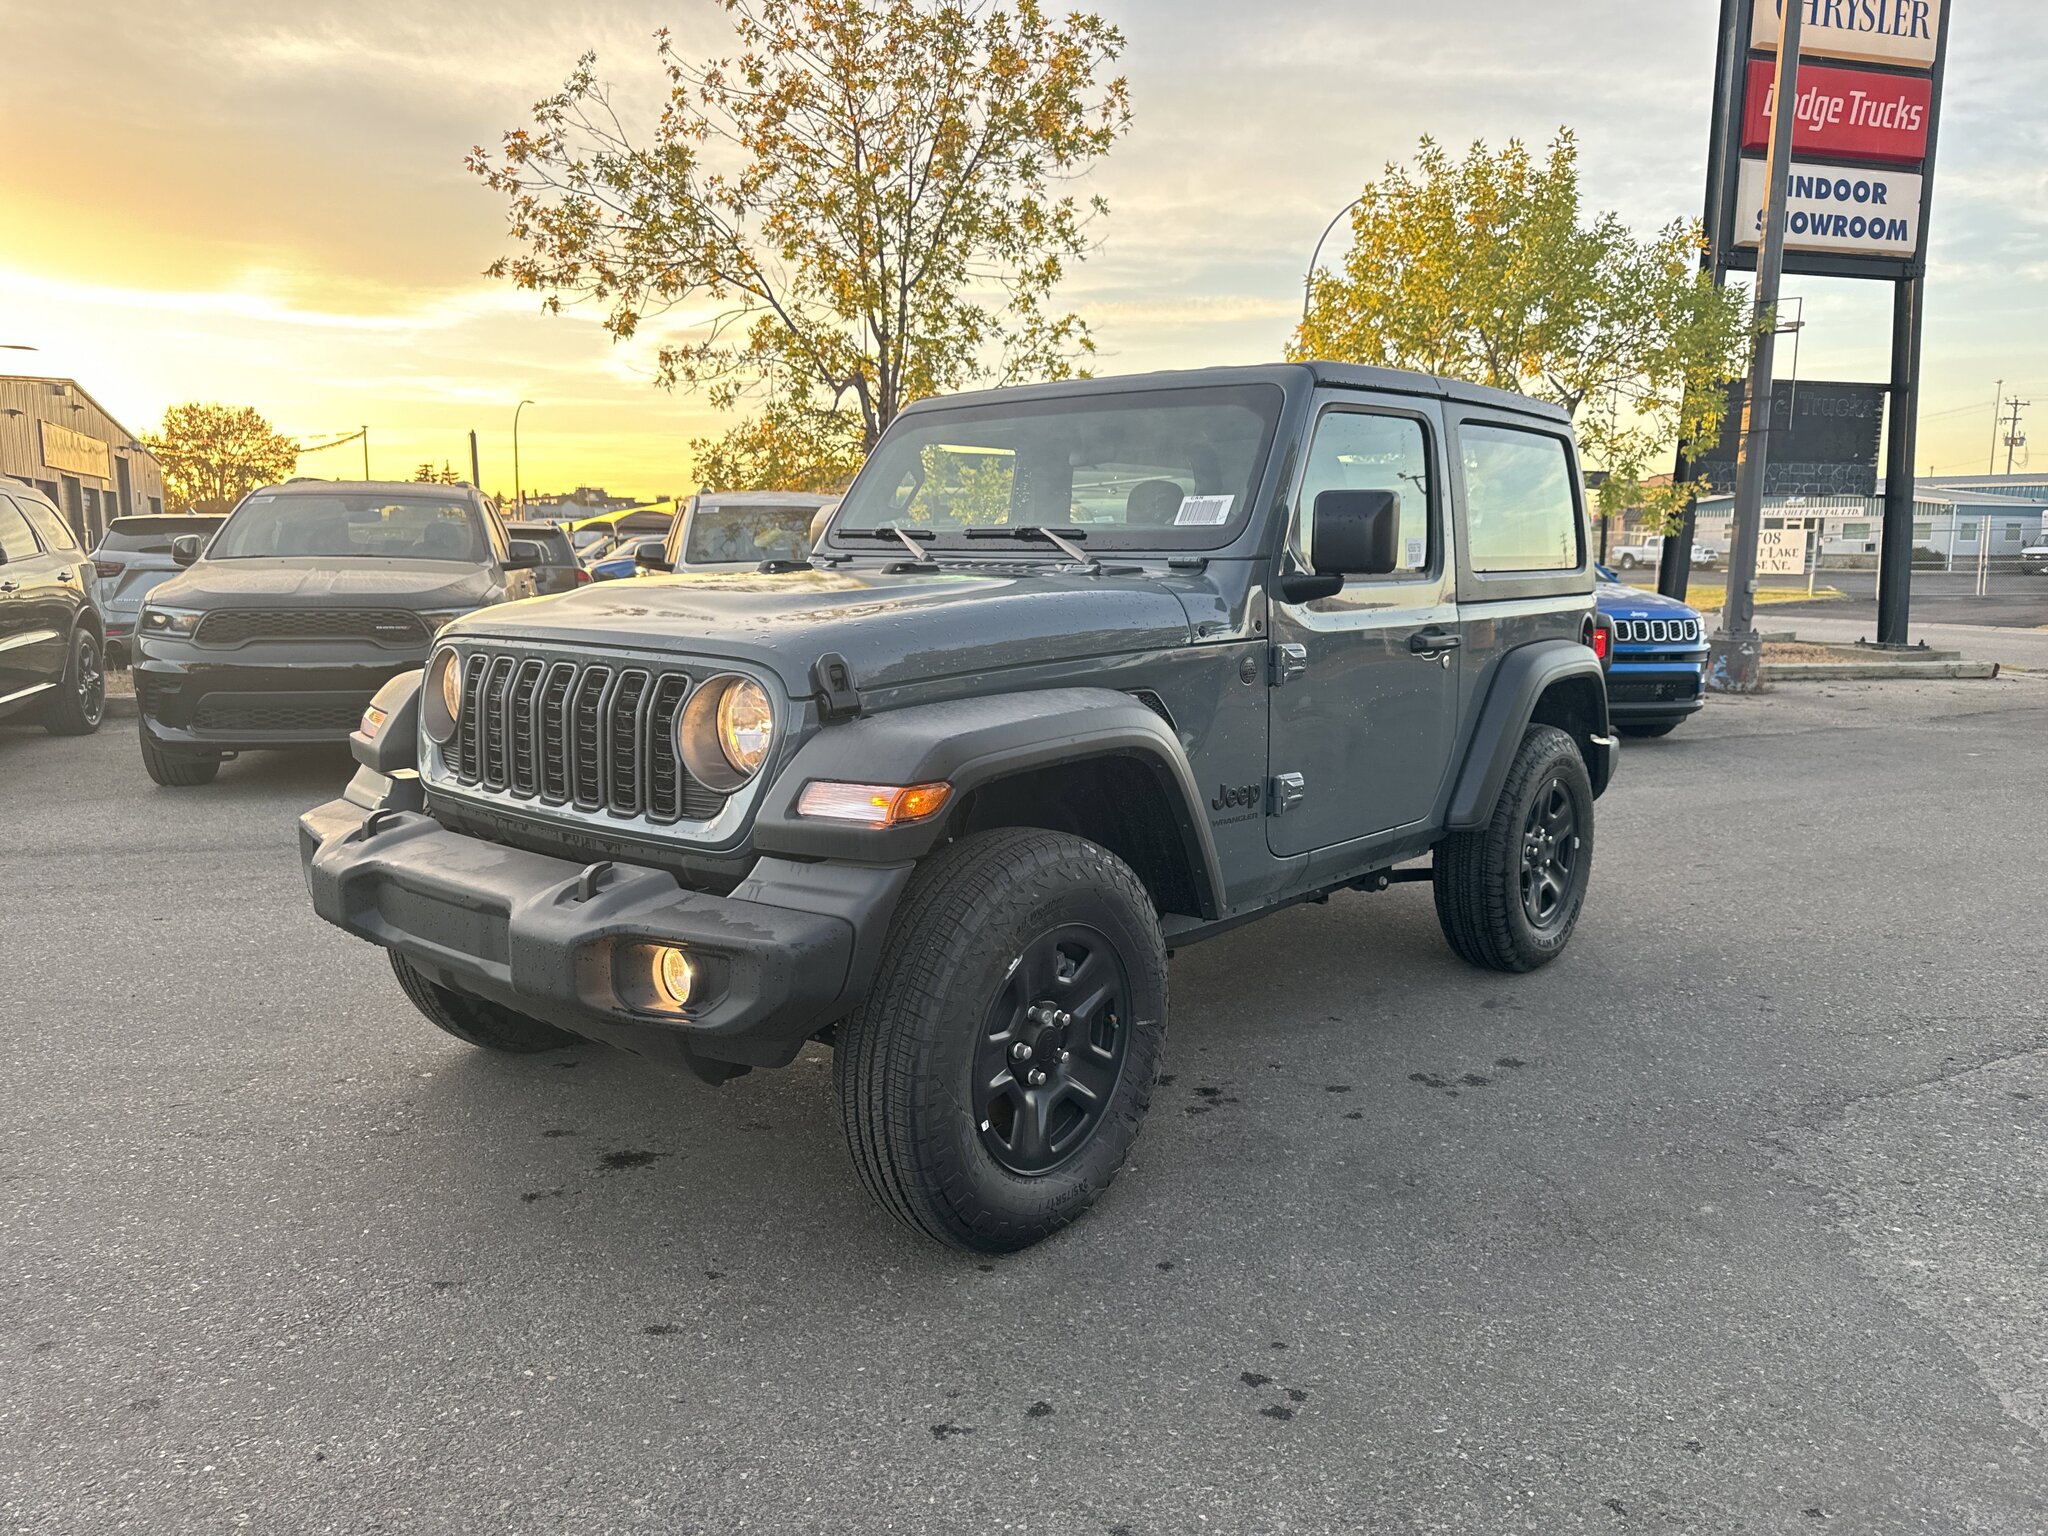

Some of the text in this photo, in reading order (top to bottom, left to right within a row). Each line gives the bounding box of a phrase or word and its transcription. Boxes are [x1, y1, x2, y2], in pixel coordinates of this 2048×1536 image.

[1776, 0, 1930, 39] HRYSLER
[1762, 83, 1923, 131] dge Trucks
[1787, 175, 1887, 204] INDOOR
[1755, 208, 1908, 241] OWROOM
[1212, 783, 1260, 811] Jeep
[1212, 813, 1258, 826] WRANGLER
